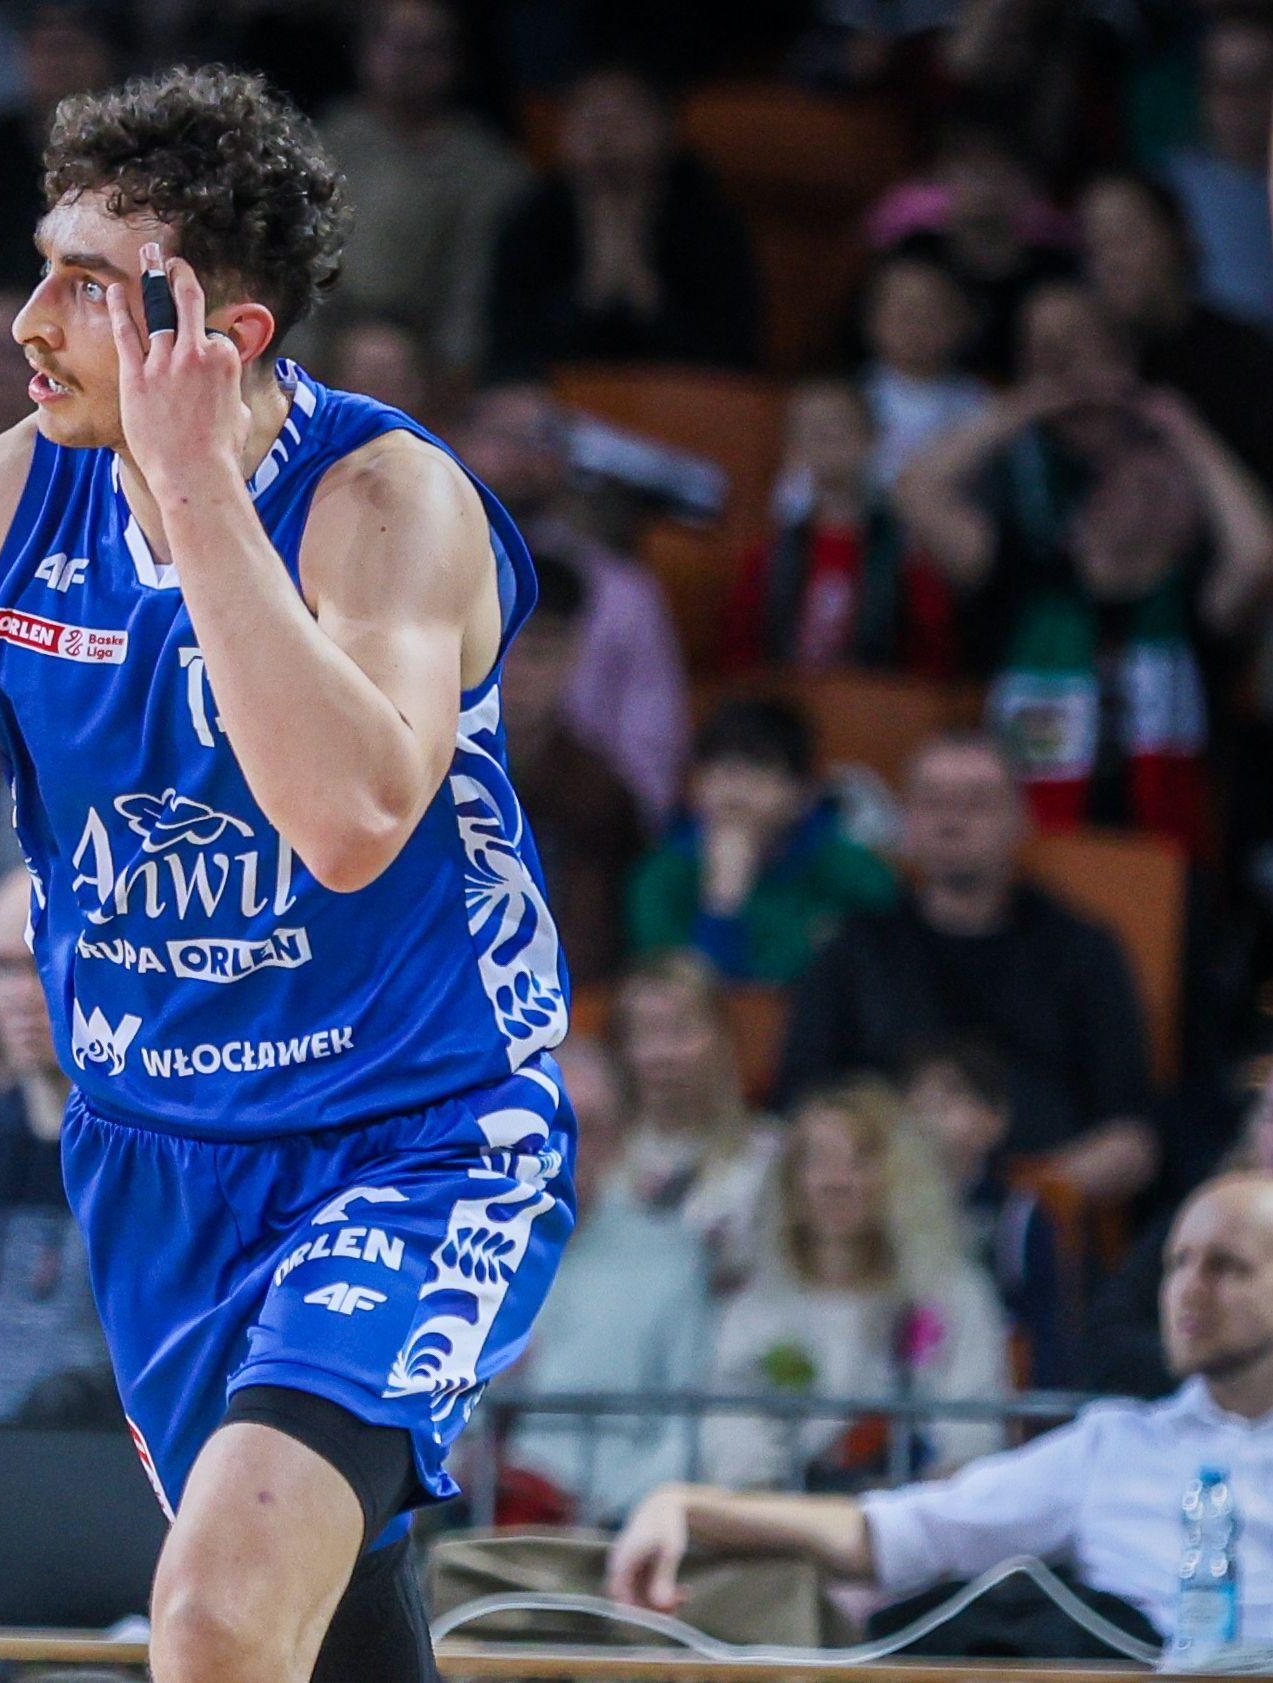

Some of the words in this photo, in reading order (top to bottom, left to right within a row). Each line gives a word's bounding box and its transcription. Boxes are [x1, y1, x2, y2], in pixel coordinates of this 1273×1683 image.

[35, 552, 89, 592] 4F
[87, 646, 113, 659] Liga
[178, 647, 226, 748] 1
[73, 806, 296, 924] Anwil
[75, 929, 167, 973] RUPA
[179, 935, 299, 977] ORLEN
[141, 1026, 354, 1078] WŁOCŁAWEK
[304, 1282, 388, 1315] 4F
